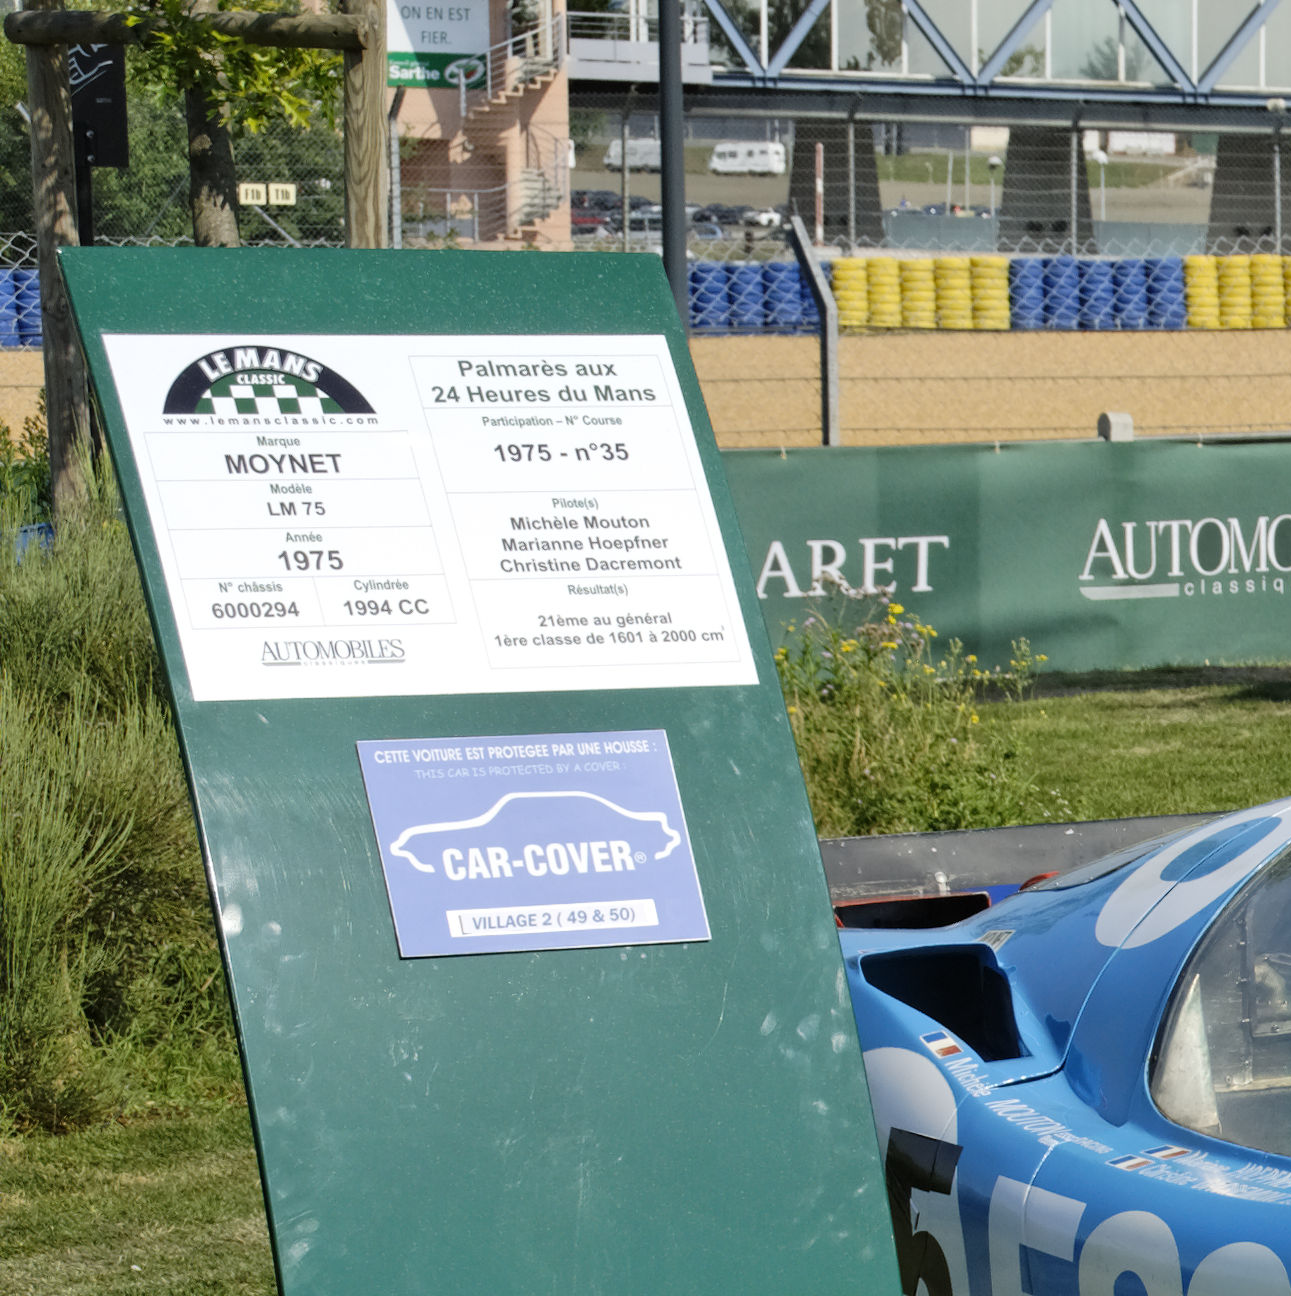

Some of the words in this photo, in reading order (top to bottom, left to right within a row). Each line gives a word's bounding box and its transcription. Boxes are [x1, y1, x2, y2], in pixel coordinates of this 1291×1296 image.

[401, 5, 421, 20] ON
[426, 6, 443, 20] EN
[448, 7, 471, 21] EST
[389, 65, 441, 80] Sarthe
[458, 359, 568, 377] Palmarès
[576, 363, 619, 377] aux
[236, 373, 286, 385] CLASSIC
[432, 386, 460, 403] 24
[466, 385, 551, 403] Heures
[558, 385, 588, 402] du
[594, 384, 657, 402] Mans
[163, 416, 379, 426] www.lemansclassic.com
[482, 415, 553, 428] Participation
[582, 415, 623, 427] Course
[256, 435, 301, 449] Marque
[494, 444, 552, 462] 1975
[574, 442, 630, 462] n°35
[224, 453, 342, 475] MOYNET
[269, 483, 313, 495] Modèle
[266, 502, 297, 516] LM
[302, 501, 326, 516] 75
[551, 498, 599, 510] Pilote(s)
[510, 516, 579, 531] Michèle
[583, 515, 650, 530] Mouton
[285, 531, 323, 543] Année
[501, 537, 584, 552] Marianne
[588, 536, 669, 553] Hoepfner
[278, 550, 344, 571] 1975
[500, 558, 581, 573] Christine
[585, 556, 682, 572] Dacremont
[238, 581, 283, 593] châssis
[354, 579, 409, 593] Cylindrée
[567, 584, 628, 596] Résultat(s)
[212, 602, 300, 619] 6000294
[343, 600, 392, 616] 1994
[399, 599, 430, 615] CC
[538, 613, 588, 627] 21ème
[593, 615, 611, 626] au
[616, 612, 672, 628] général
[494, 635, 528, 648] 1ère
[532, 633, 581, 646] classe
[586, 632, 605, 645] de
[609, 632, 644, 644] 1601
[649, 630, 658, 643] à
[662, 630, 697, 643] 2000
[261, 638, 406, 662] AUTOMOBILES
[374, 750, 410, 764] CETTE
[412, 748, 463, 762] VOITURE
[465, 747, 484, 760] EST
[489, 743, 550, 759] PROTEGEE
[552, 742, 576, 757] PAR
[578, 741, 601, 756] UNE
[604, 740, 650, 756] HOUSSE
[415, 769, 445, 780] THIS
[447, 767, 470, 778] CAR
[473, 766, 487, 777] IS
[488, 763, 554, 777] PROTECTED
[556, 762, 571, 774] BY
[574, 762, 584, 773] A
[584, 760, 621, 772] COVER
[472, 913, 537, 931] VILLAGE
[542, 912, 553, 927] 2
[567, 911, 588, 926] 49
[592, 909, 606, 923] &
